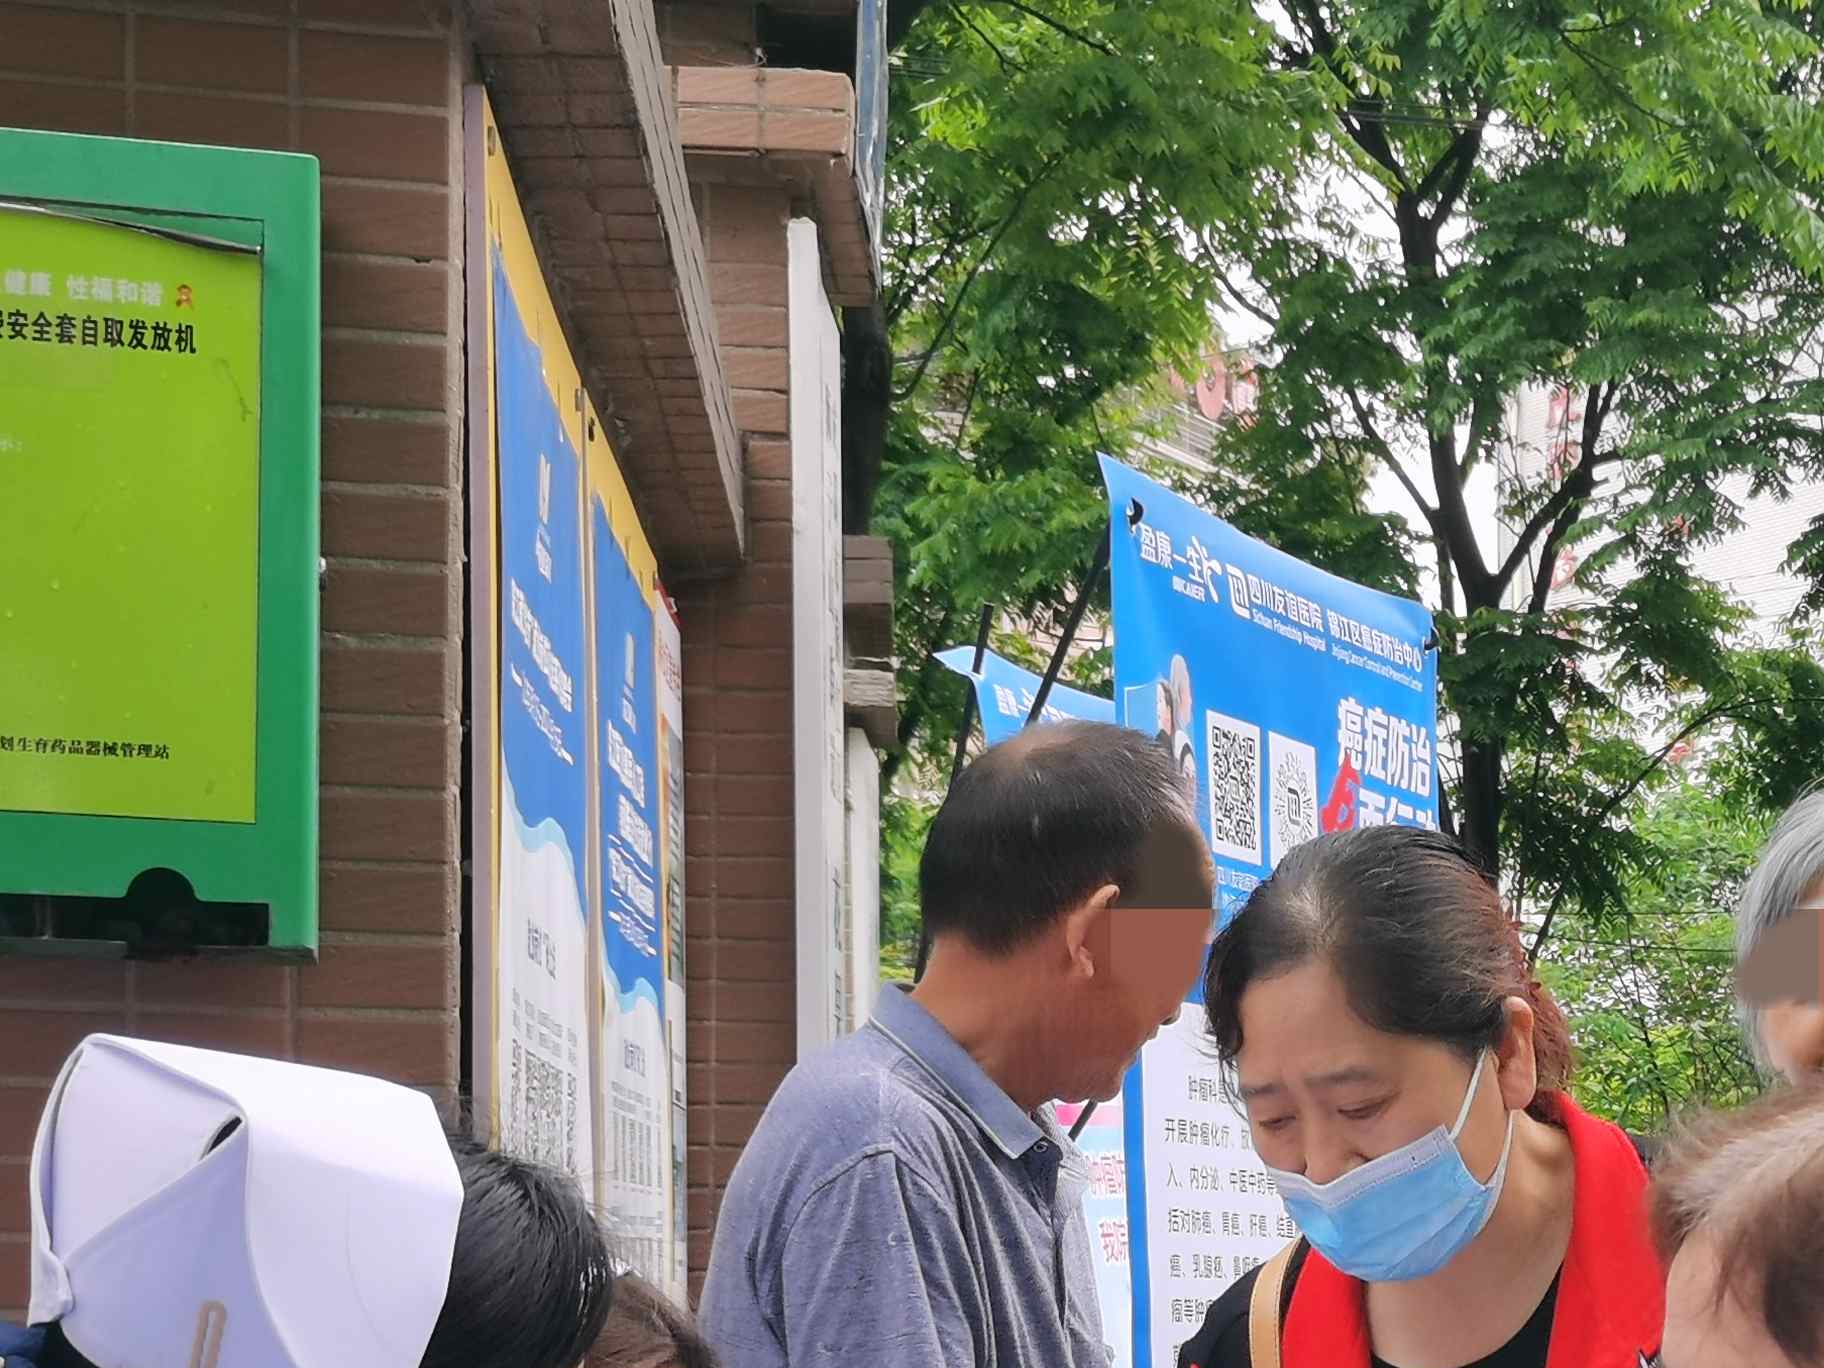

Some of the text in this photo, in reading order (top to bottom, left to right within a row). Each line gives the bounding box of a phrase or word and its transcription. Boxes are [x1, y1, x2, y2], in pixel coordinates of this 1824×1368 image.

[1246, 574, 1423, 673] 四川友谊医院 锦江区癌症防治中心
[1337, 696, 1431, 798] 癌症防治
